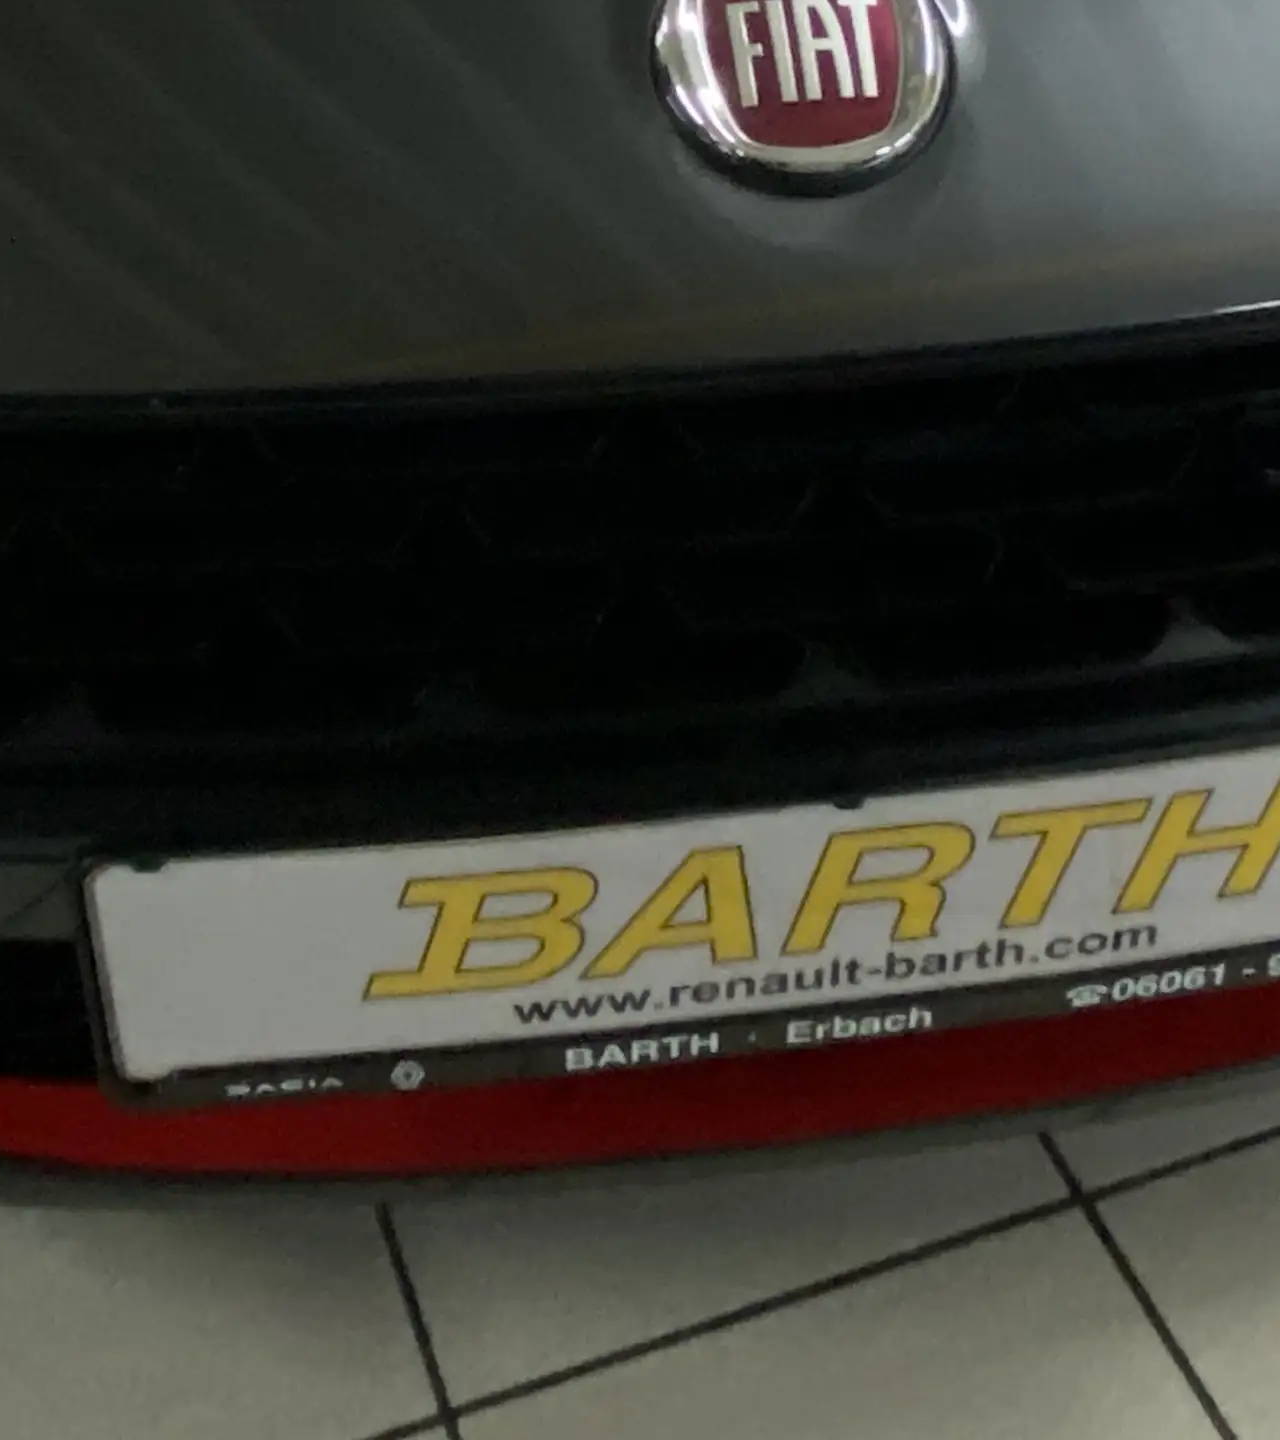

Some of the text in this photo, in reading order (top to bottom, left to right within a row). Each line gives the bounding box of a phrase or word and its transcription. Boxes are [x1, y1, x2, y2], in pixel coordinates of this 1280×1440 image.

[513, 922, 1158, 1024] www.renault-barth.com
[1111, 962, 1226, 1003] 06061
[565, 1032, 721, 1073] BARTH
[785, 1006, 933, 1045] Erbach
